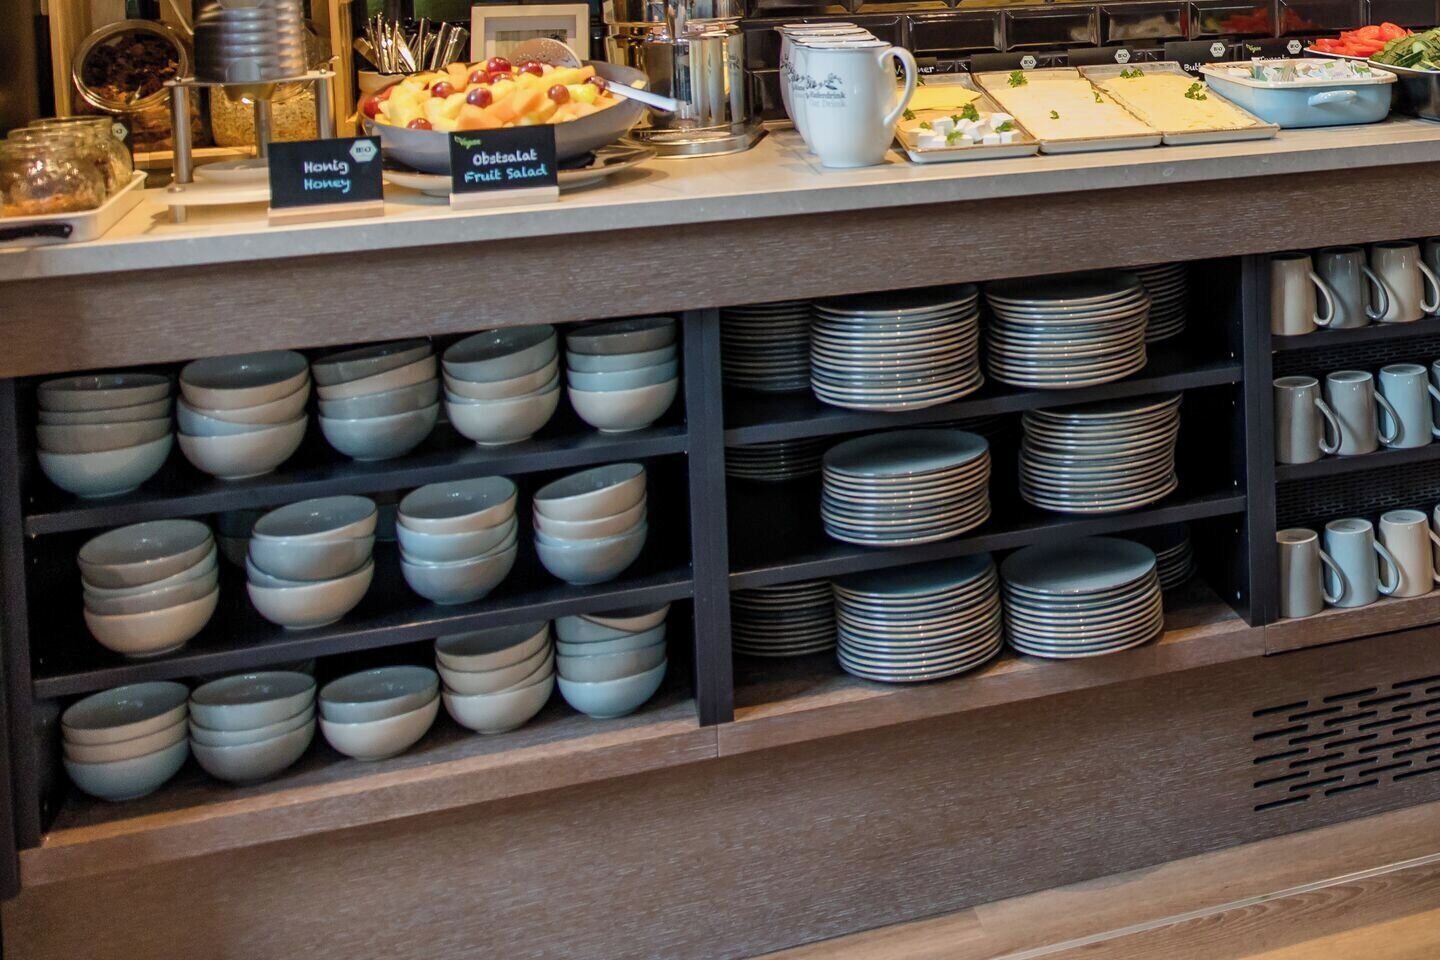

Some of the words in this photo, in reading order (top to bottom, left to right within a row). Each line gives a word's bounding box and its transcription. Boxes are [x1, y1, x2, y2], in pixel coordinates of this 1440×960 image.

[473, 149, 537, 166] Obstsalat
[304, 161, 349, 174] Honig
[464, 169, 502, 183] Fruit
[507, 164, 548, 179] Salad
[304, 178, 350, 192] Honey
